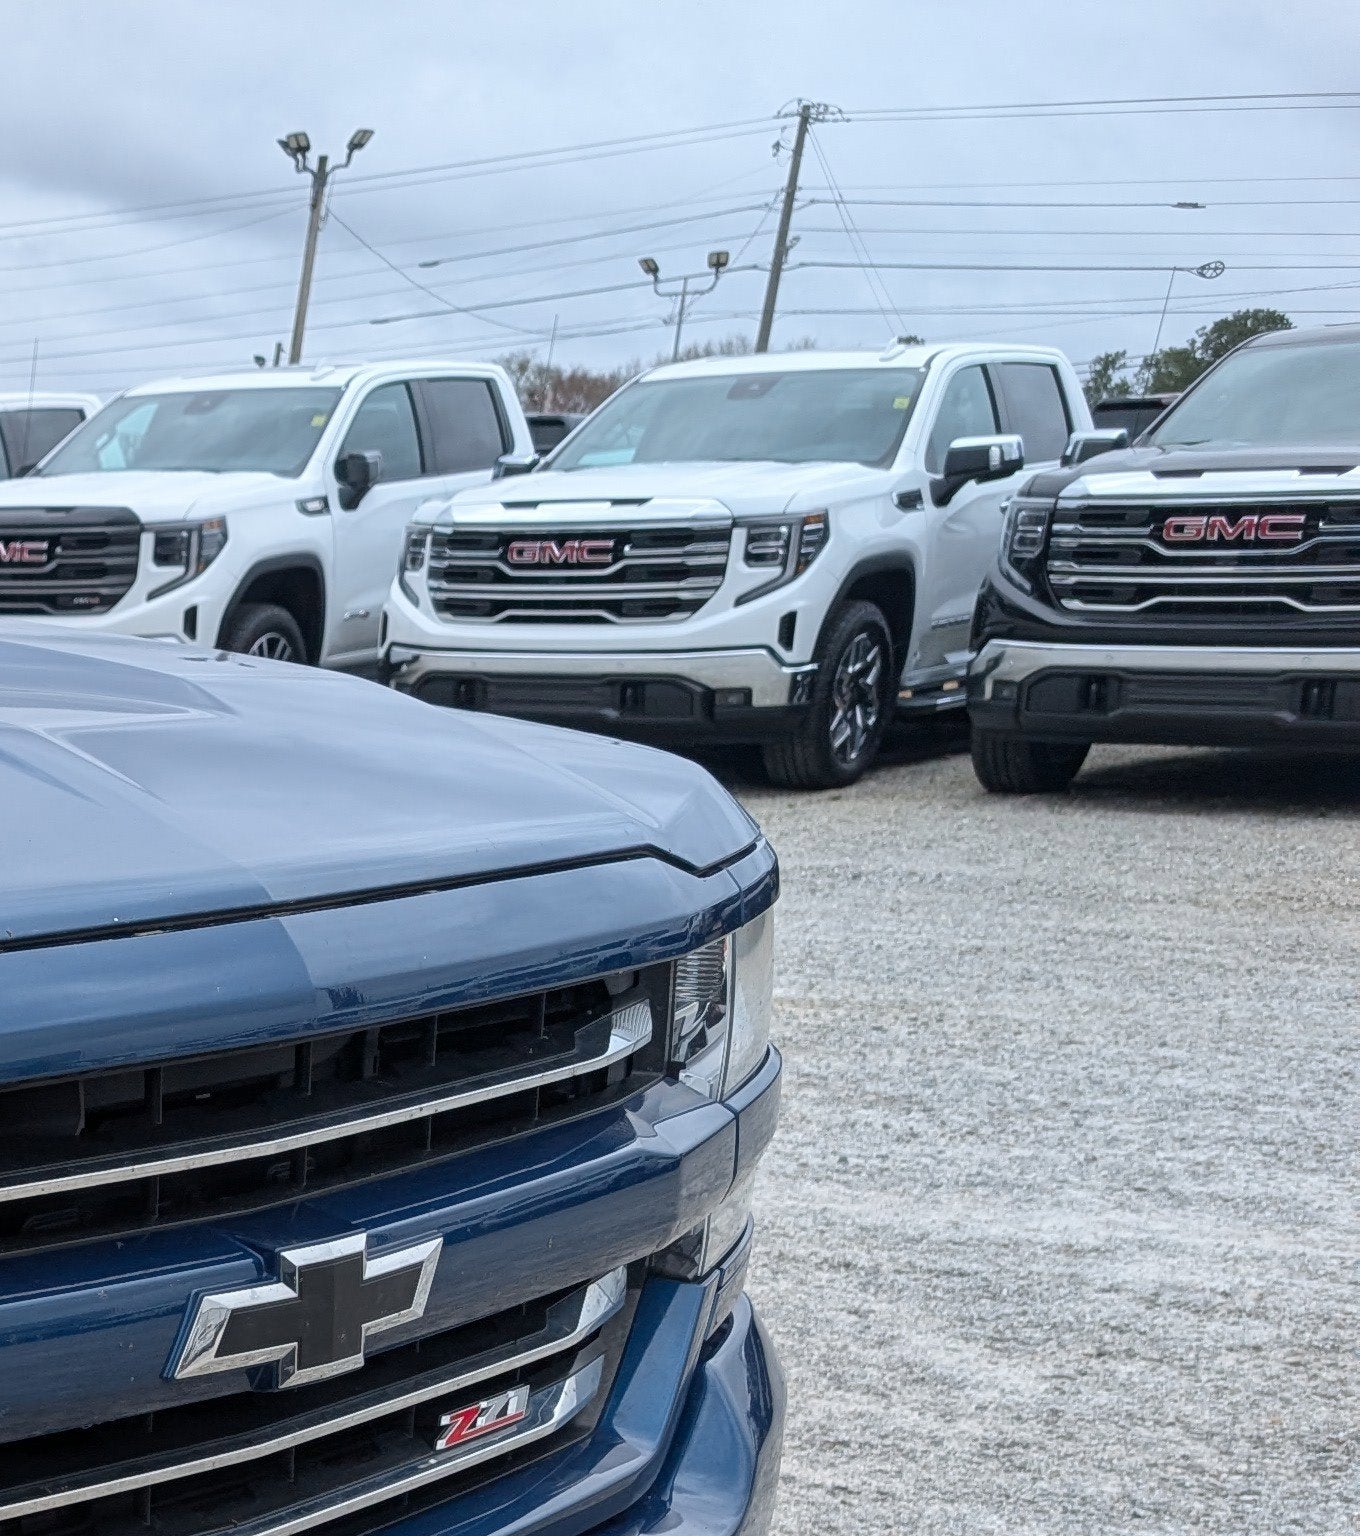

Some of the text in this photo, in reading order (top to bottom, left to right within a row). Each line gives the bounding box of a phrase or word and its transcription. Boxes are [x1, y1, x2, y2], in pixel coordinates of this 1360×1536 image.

[1162, 515, 1306, 541] GMC
[507, 539, 616, 564] GMC
[435, 1385, 530, 1450] Z71
